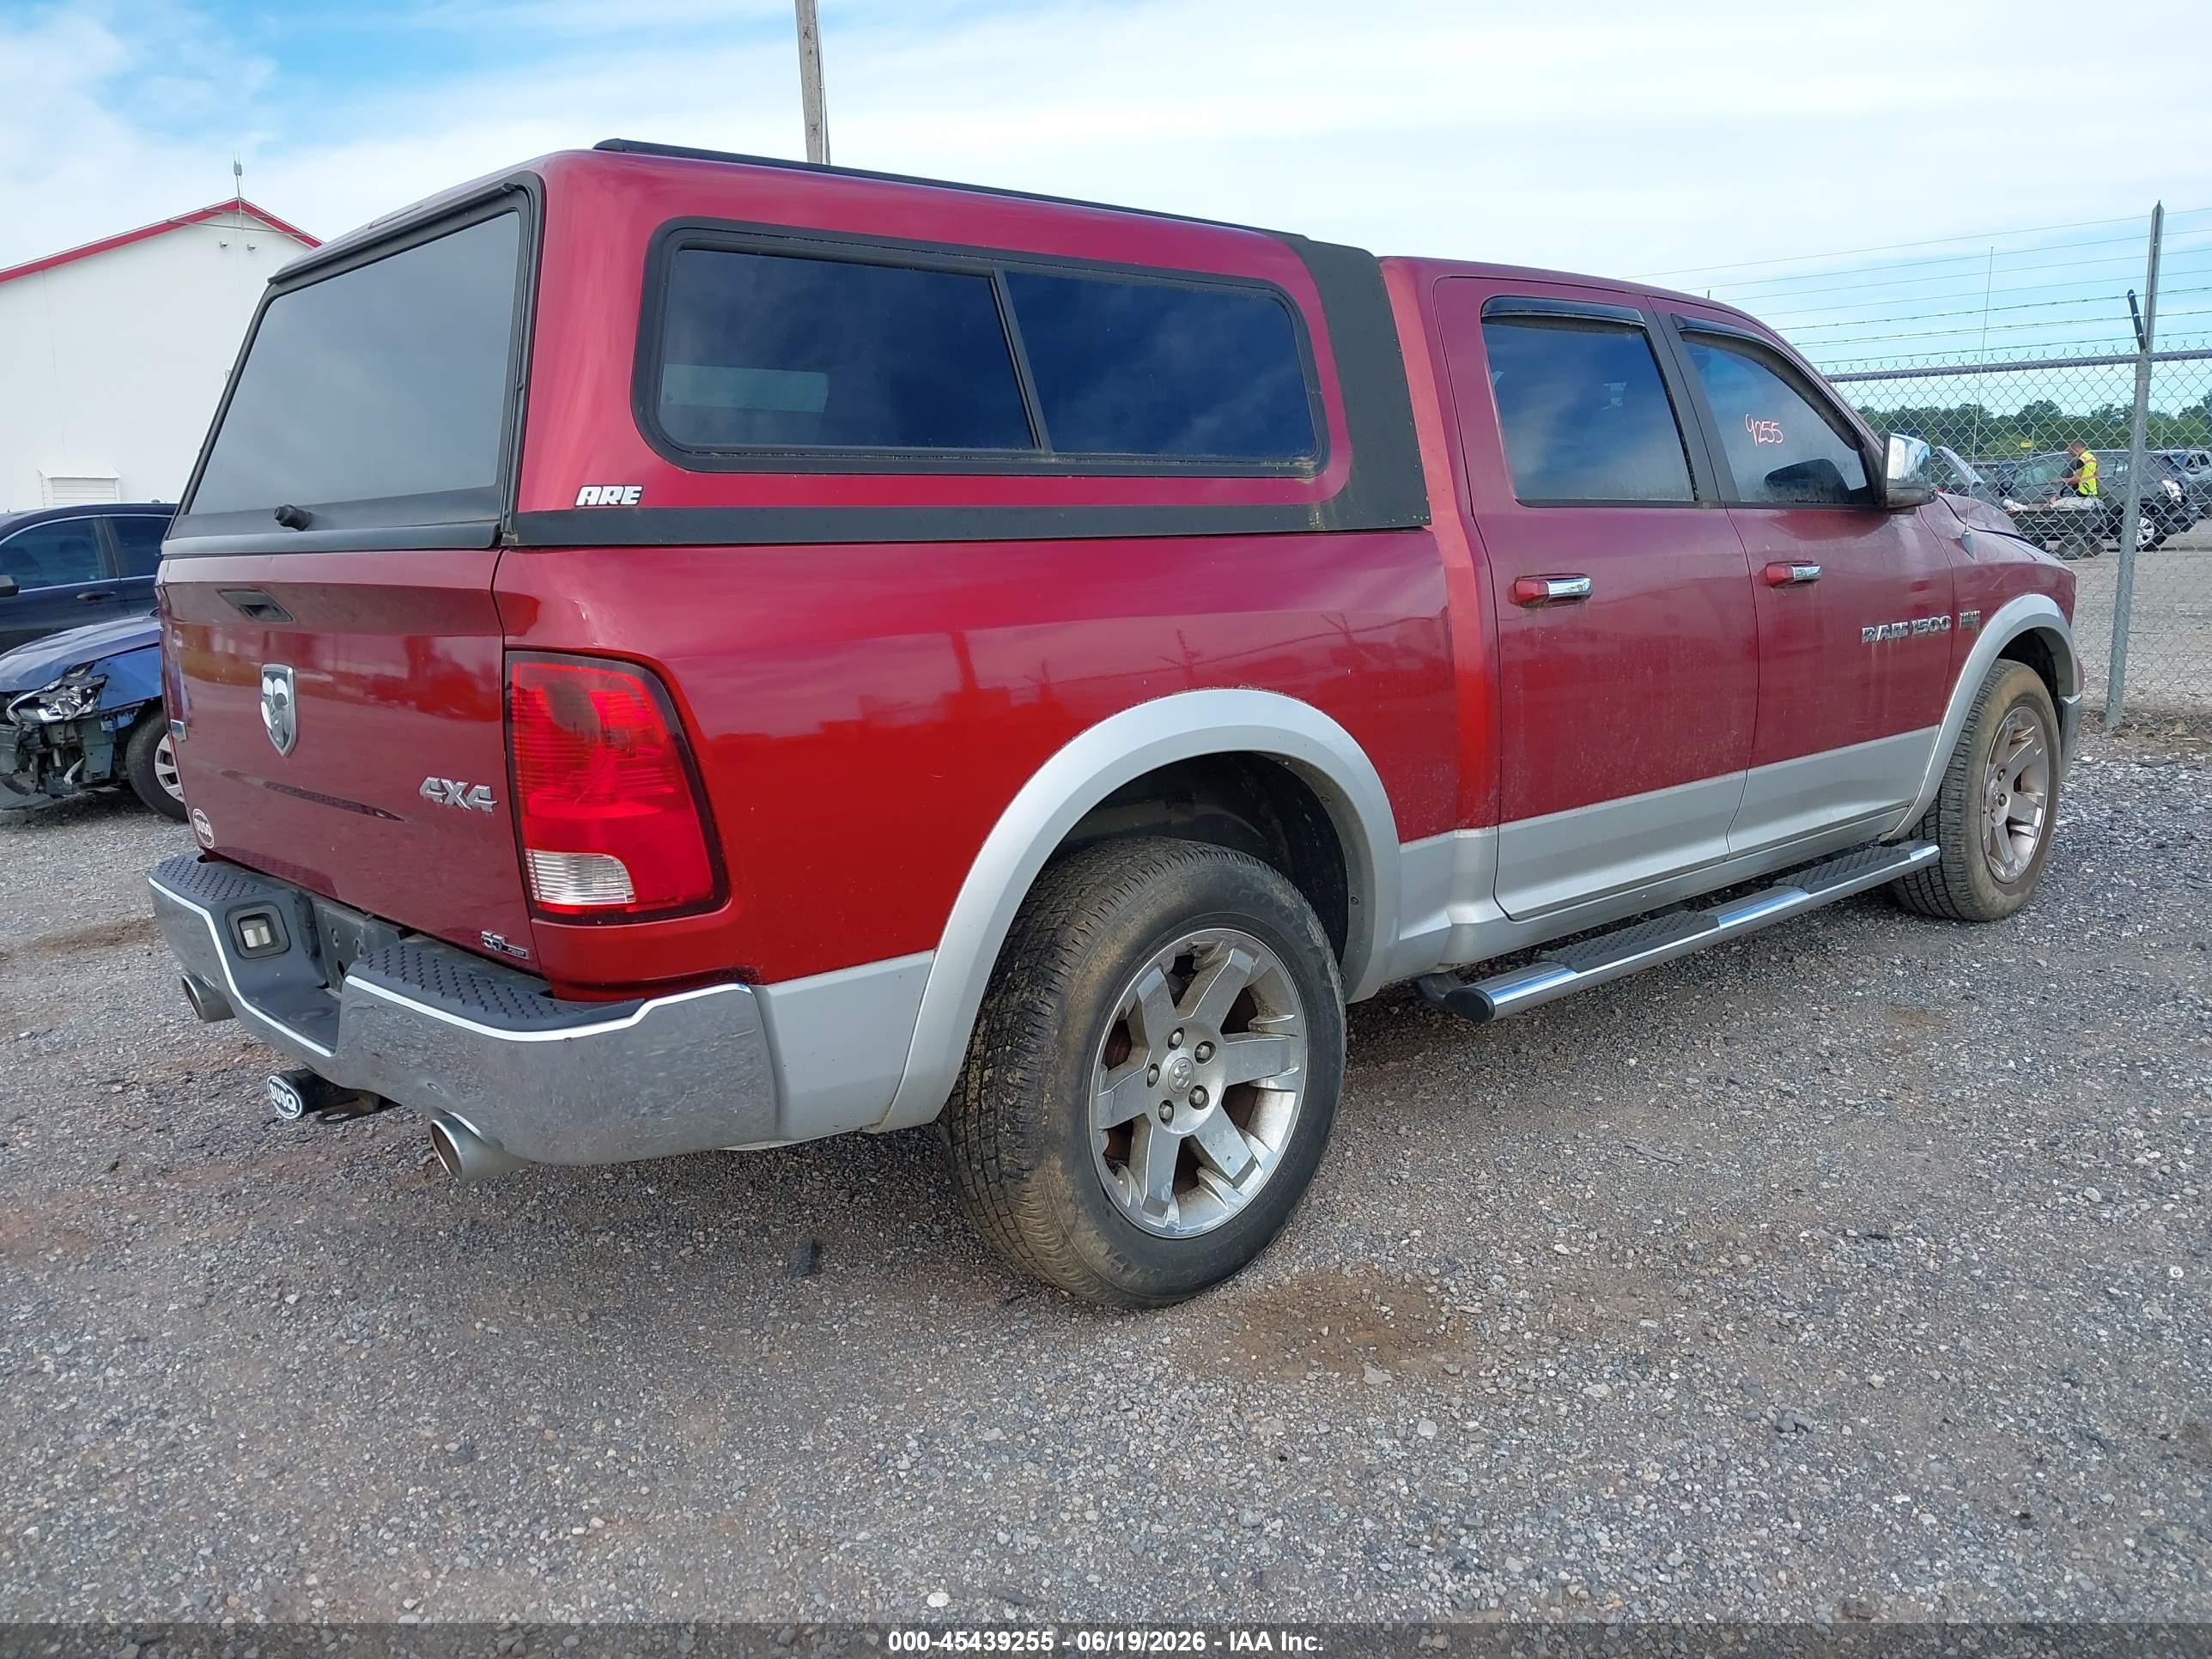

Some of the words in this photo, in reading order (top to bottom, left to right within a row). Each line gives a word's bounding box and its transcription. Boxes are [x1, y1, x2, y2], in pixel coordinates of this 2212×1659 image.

[574, 485, 643, 507] ARE
[1911, 615, 1952, 635] 1500
[269, 1083, 297, 1112] SUSQ
